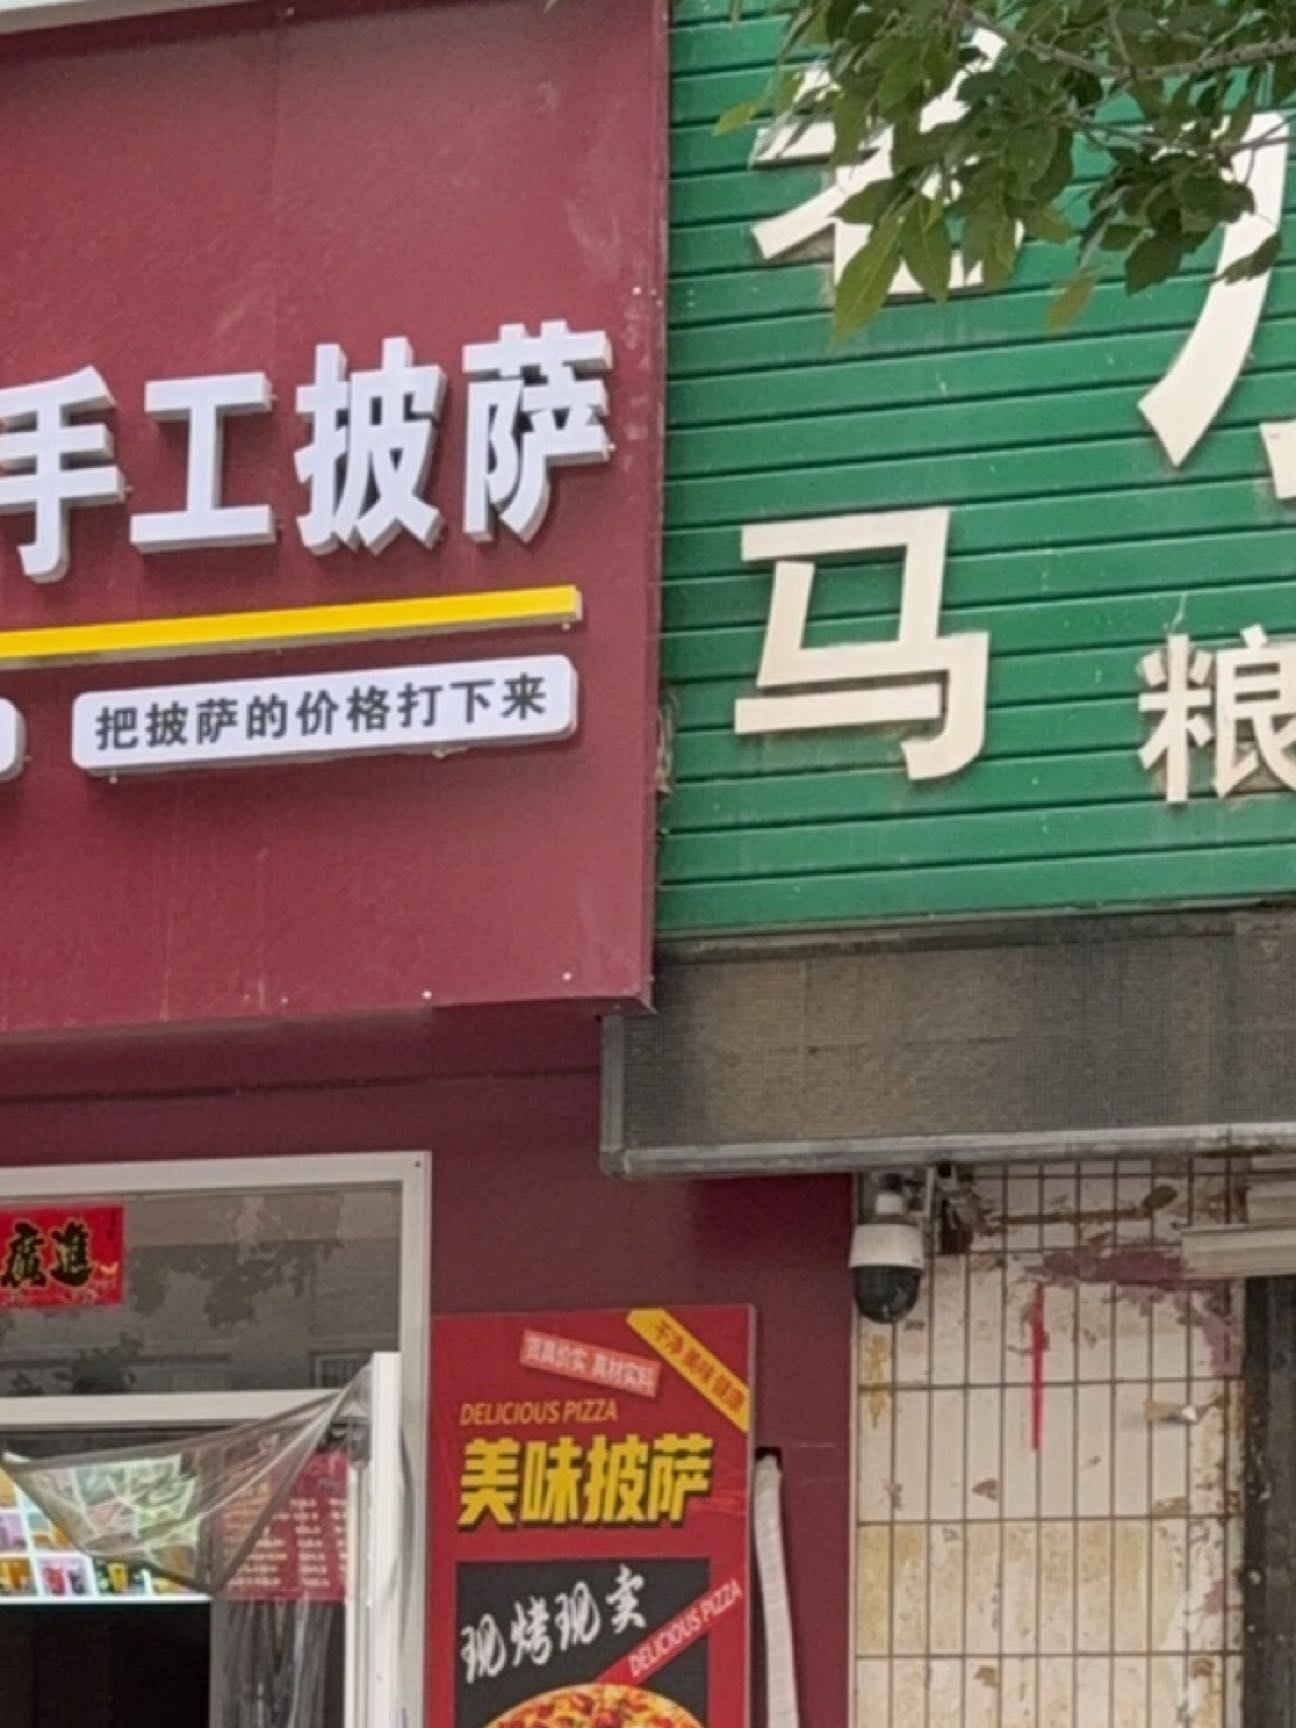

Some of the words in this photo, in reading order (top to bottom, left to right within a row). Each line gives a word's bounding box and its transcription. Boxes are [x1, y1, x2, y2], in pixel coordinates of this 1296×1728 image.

[733, 507, 990, 782] 马
[94, 672, 548, 751] 把披萨的价格打下来
[460, 1400, 559, 1426] DELICIOUS
[562, 1398, 619, 1423] PIZZA
[458, 1432, 714, 1530] 美味披萨
[627, 1610, 702, 1678] DELICIOUS
[702, 1579, 743, 1626] PIZZA
